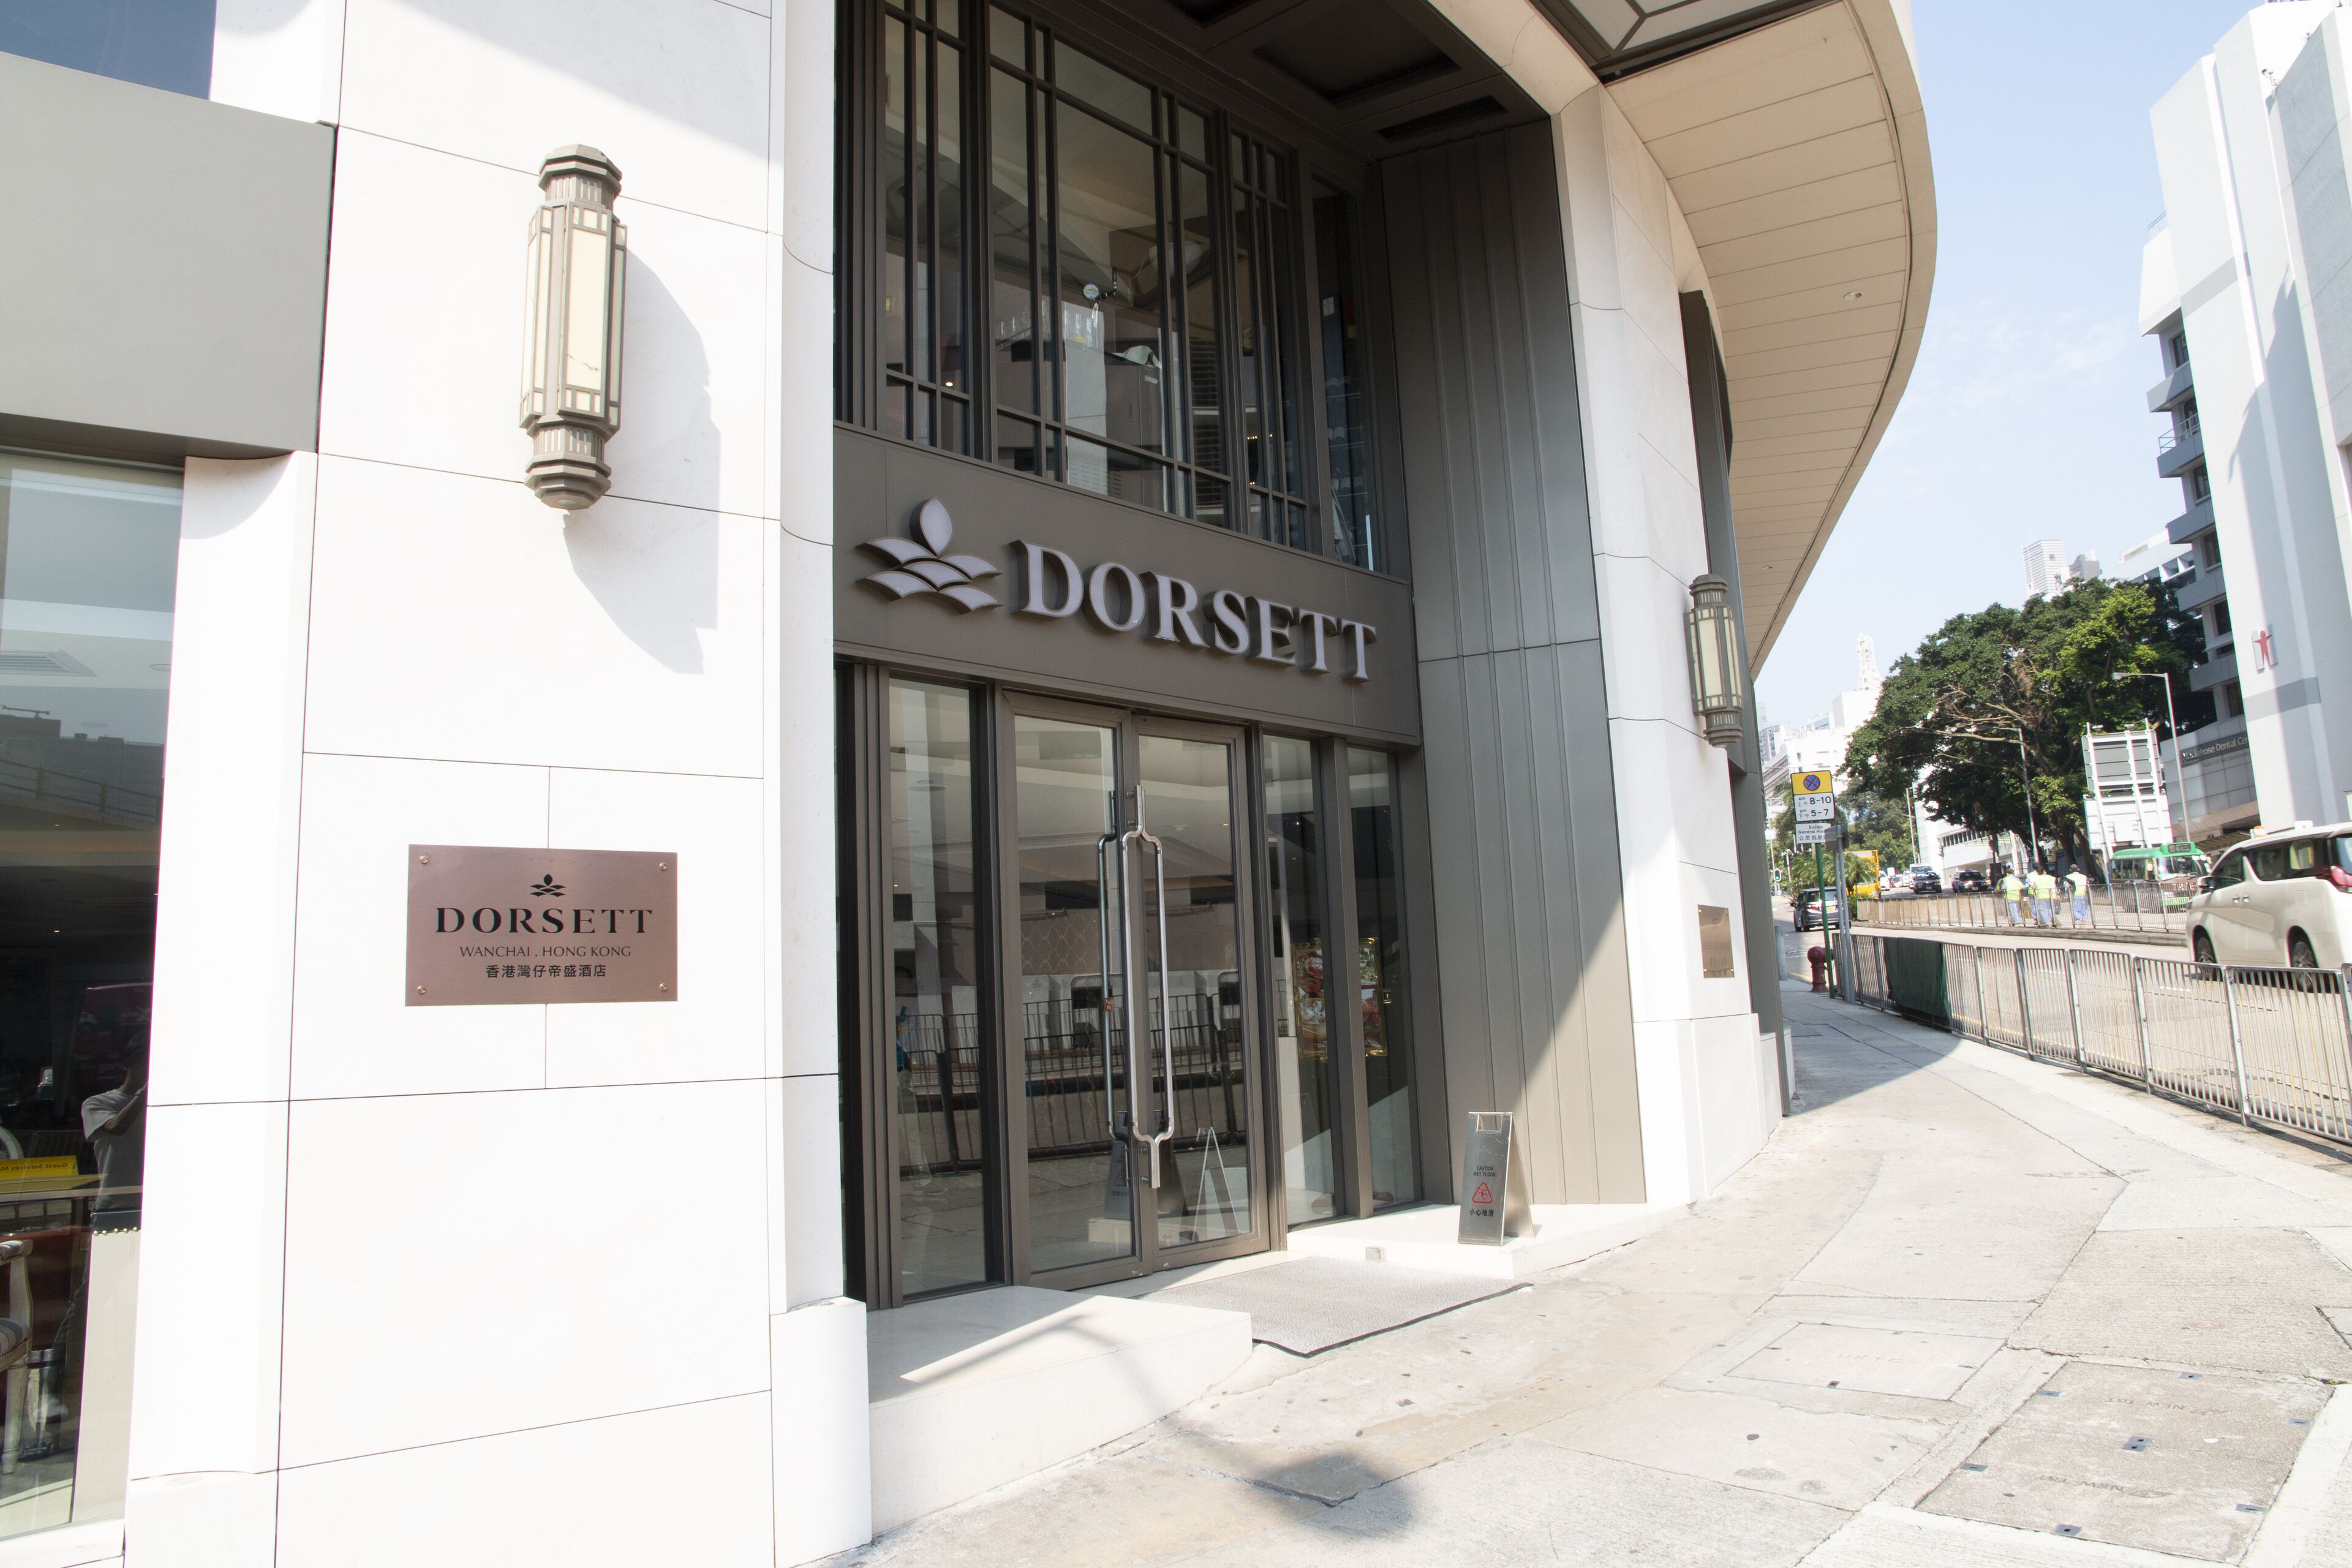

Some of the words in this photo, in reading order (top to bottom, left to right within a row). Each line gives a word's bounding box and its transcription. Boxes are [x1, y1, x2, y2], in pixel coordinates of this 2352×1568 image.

[1008, 540, 1377, 682] DORSETT
[2215, 738, 2237, 751] Dental
[435, 907, 653, 933] DORSETT
[460, 946, 530, 957] WANCHAI
[542, 946, 586, 957] HONG
[591, 946, 631, 957] KONG
[486, 964, 606, 978] 香港灣仔帝盛酒店
[1469, 1208, 1494, 1217] 小心地滑
